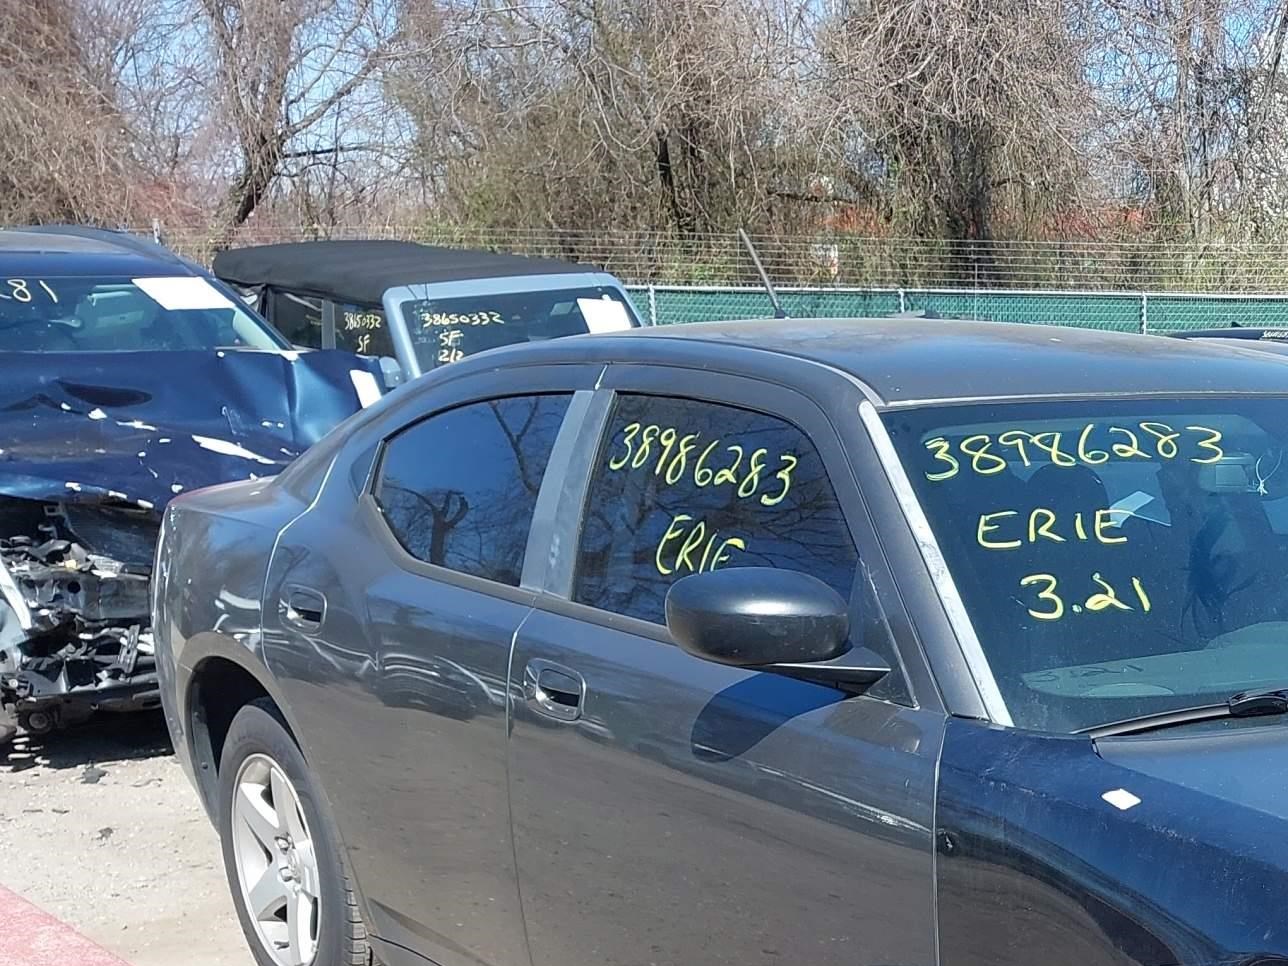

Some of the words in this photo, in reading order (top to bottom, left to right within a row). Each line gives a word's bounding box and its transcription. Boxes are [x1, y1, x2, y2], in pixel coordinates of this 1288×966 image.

[0, 278, 58, 303] 81
[422, 311, 505, 328] 38650332
[356, 334, 371, 354] SF
[439, 329, 465, 347] SF
[609, 422, 798, 506] 38986283
[925, 422, 1225, 482] 38986283
[977, 507, 1129, 548] ERIE
[1020, 571, 1151, 620] 3.21
